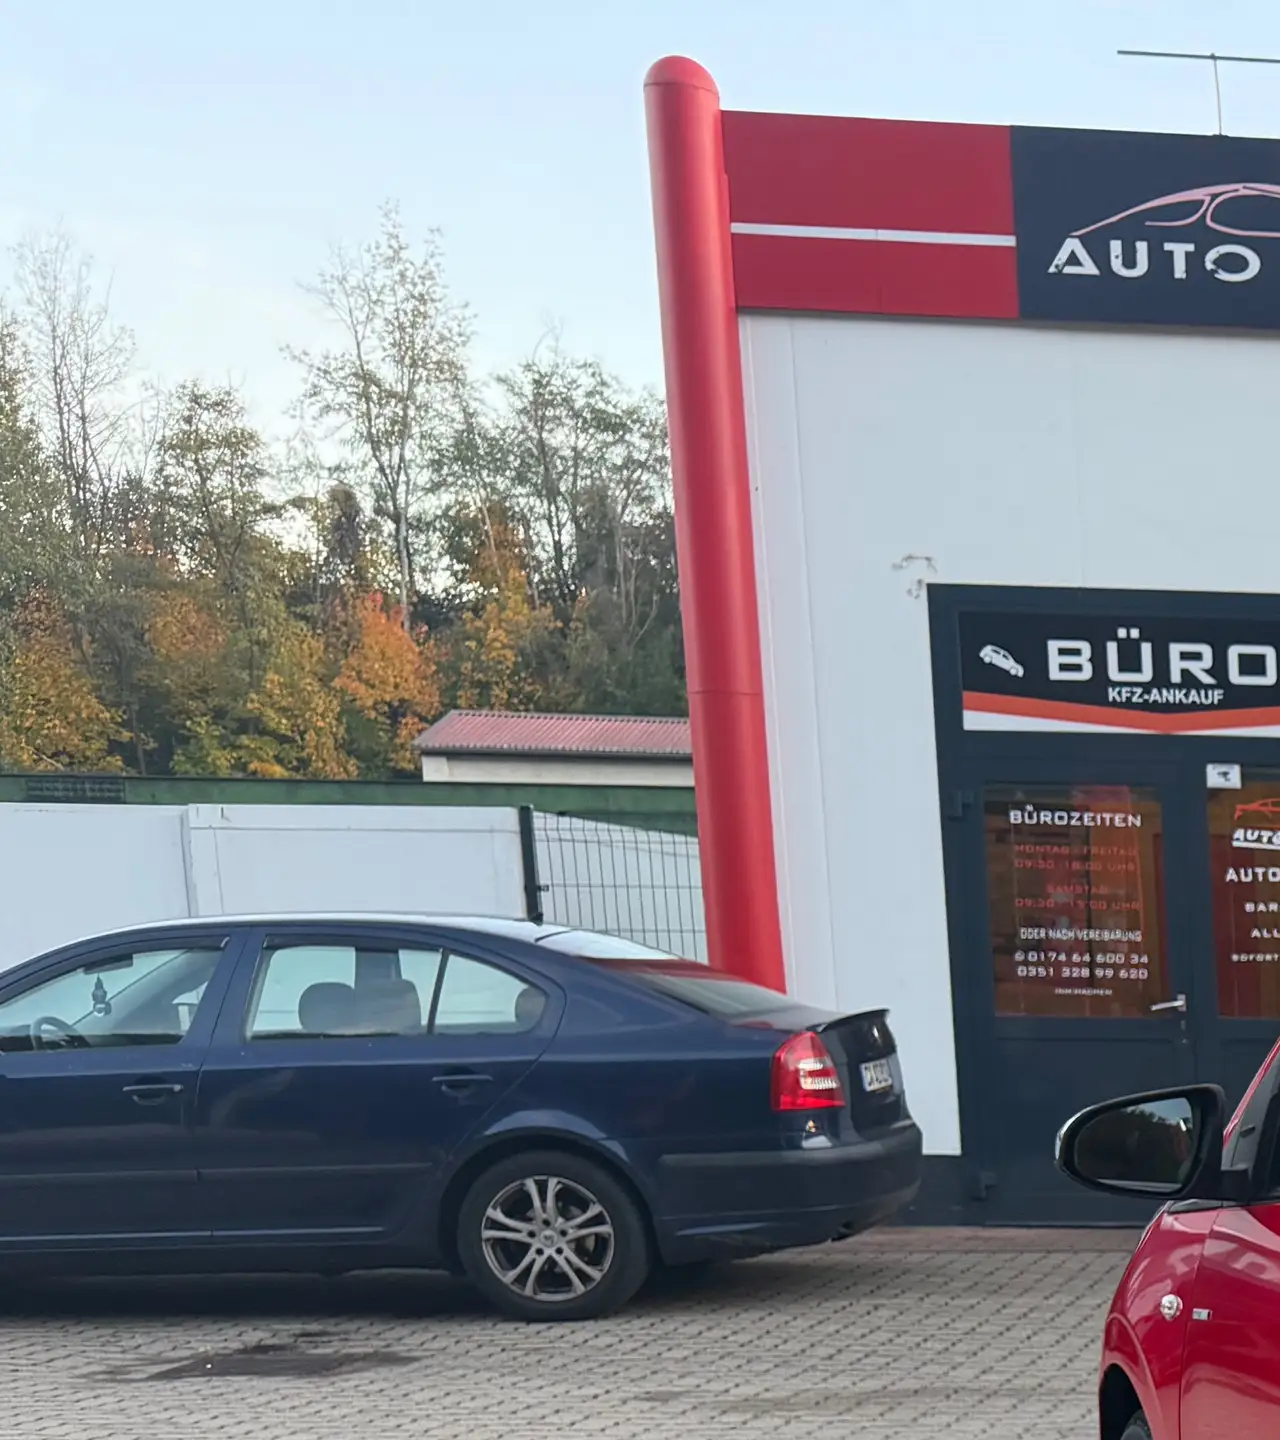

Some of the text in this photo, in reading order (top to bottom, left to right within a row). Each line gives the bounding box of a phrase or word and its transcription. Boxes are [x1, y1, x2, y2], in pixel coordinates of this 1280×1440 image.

[1047, 236, 1262, 283] AUTO
[1045, 627, 1279, 687] BÜRO
[1107, 686, 1226, 707] KFZ-ANKAUF
[1008, 804, 1143, 828] BÜROZEITEN
[1020, 926, 1046, 940] ODER
[1027, 950, 1067, 963] 0174
[1071, 951, 1091, 963] 64
[1129, 953, 1149, 965] 34
[1017, 965, 1149, 980] 0351 328 99 620
